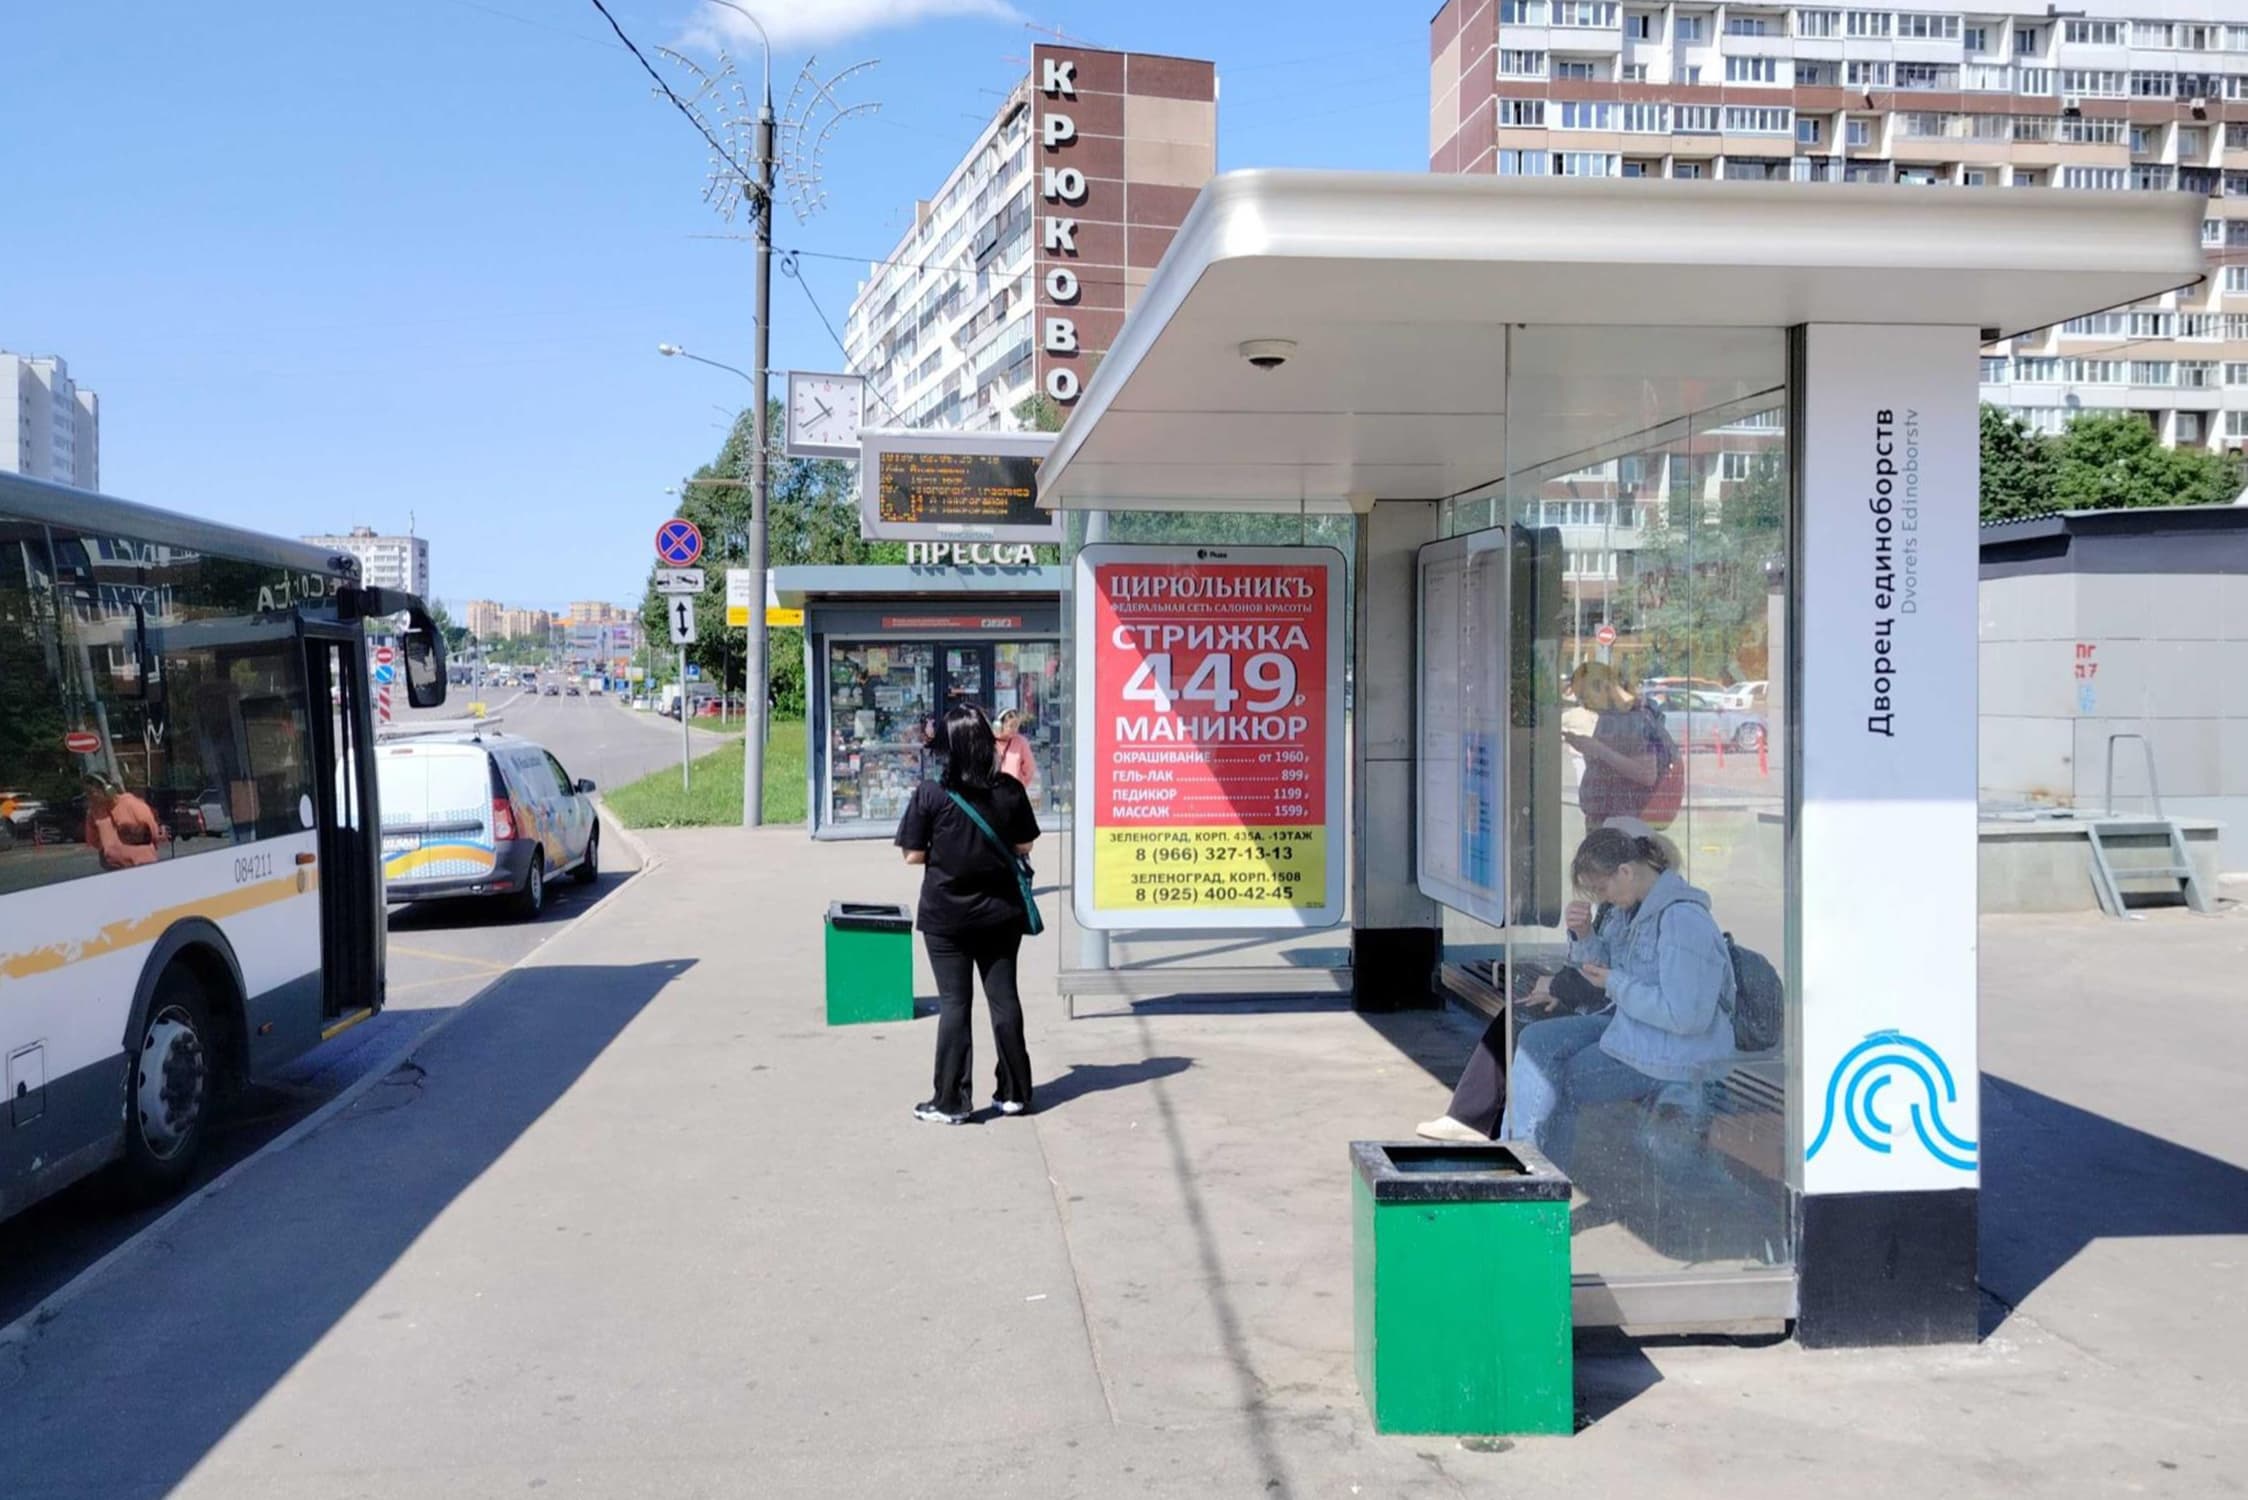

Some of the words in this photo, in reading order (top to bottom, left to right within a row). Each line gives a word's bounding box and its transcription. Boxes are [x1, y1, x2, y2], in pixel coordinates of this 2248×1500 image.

[1043, 59, 1086, 400] КРЮКОВО
[1902, 408, 1918, 531] Edinoborstv
[1869, 408, 1898, 610] единоборств
[909, 542, 1036, 564] ПРЕССА
[1901, 538, 1918, 614] Dvorets
[1111, 576, 1314, 600] ЦИРЮЛЬНИКЪ
[1111, 603, 1186, 614] ФЕДЕРАЛЬНАЯ
[1188, 604, 1213, 613] СЕТЬ
[1214, 604, 1263, 613] САЛОНОВ
[1265, 604, 1312, 613] КРАСОТЫ
[1112, 625, 1309, 650] СТРИЖКА
[1868, 618, 1897, 737] Дворец
[1115, 716, 1308, 741] МАНИКЮР
[1113, 752, 1211, 763] ОКРАШИВАНИЕ
[1259, 754, 1272, 762] от
[1113, 770, 1173, 782] ГЕЛЬ-ЛАК
[1113, 788, 1177, 801] ПЕДИКЮР
[1274, 788, 1301, 800] 1199
[1113, 806, 1170, 818] МАССАЖ
[1110, 832, 1192, 843] ЗЕЛЕНОГРАД,
[1195, 832, 1230, 842] КОРП.
[1136, 848, 1146, 861] 8
[1153, 847, 1199, 863] (966)
[1205, 847, 1293, 861] 327-13-13
[234, 852, 273, 884] 084211
[1131, 873, 1226, 884] ЗЕЛЕНОГРАД,
[1136, 888, 1146, 901] 8
[1153, 887, 1199, 903] (925)
[1205, 887, 1293, 901] 400-42-45
